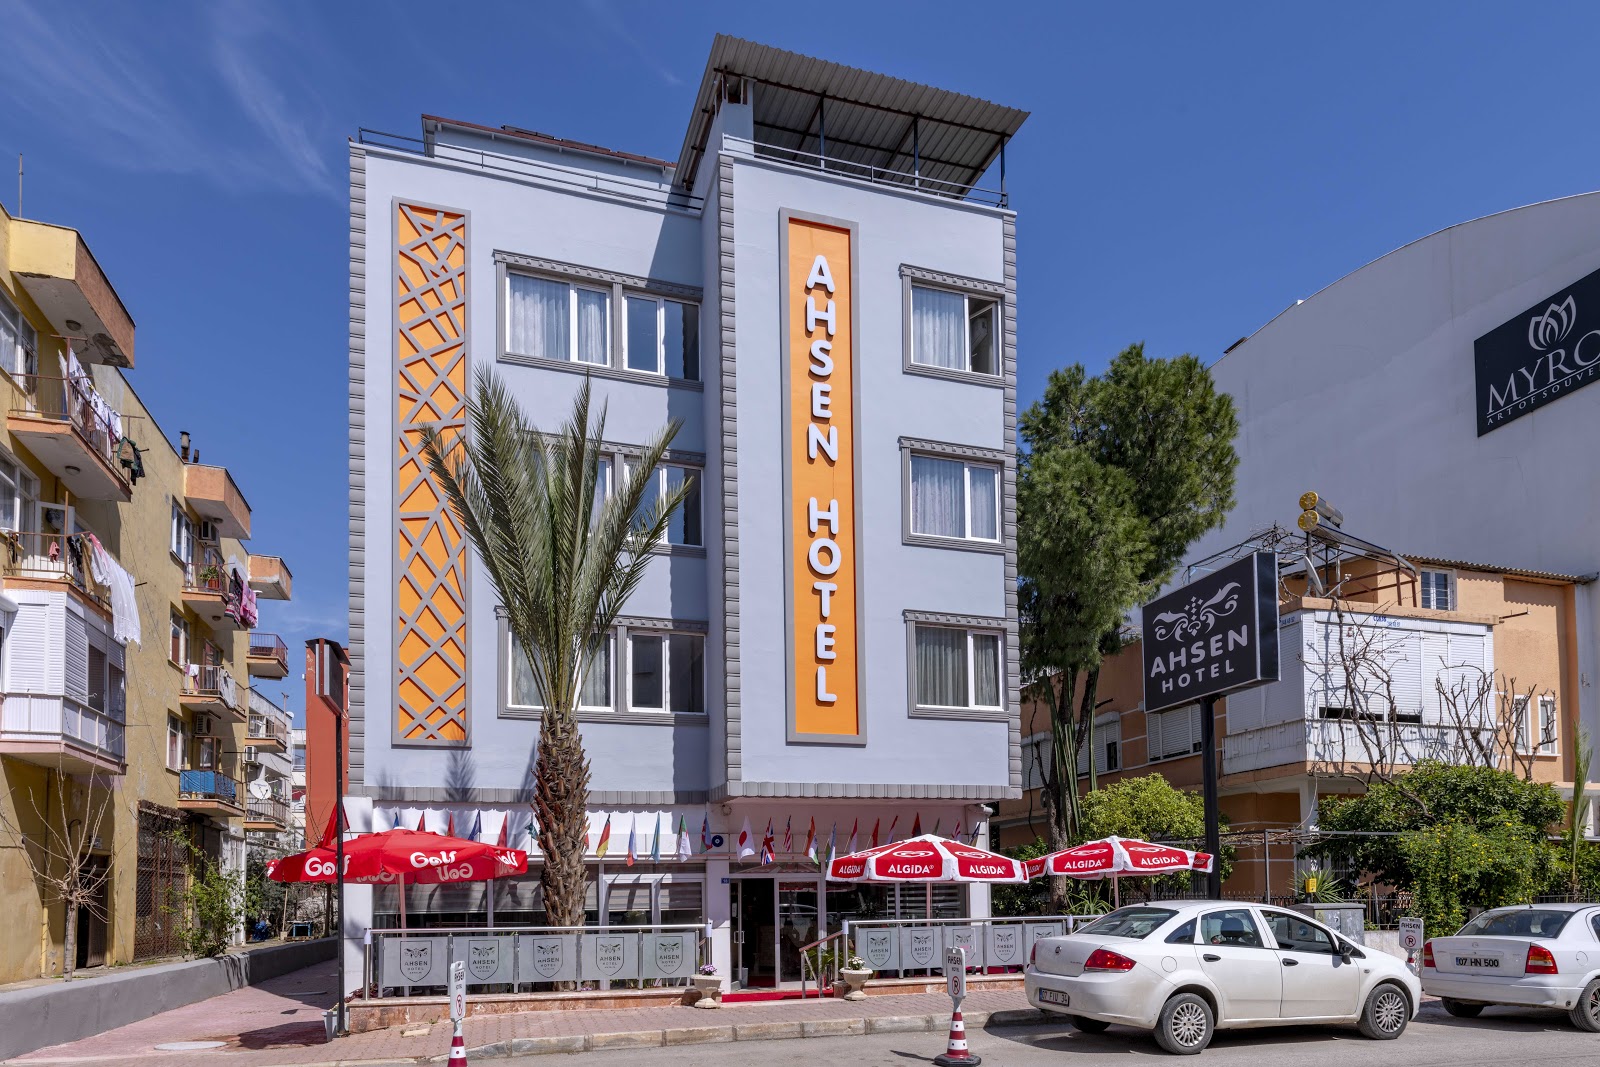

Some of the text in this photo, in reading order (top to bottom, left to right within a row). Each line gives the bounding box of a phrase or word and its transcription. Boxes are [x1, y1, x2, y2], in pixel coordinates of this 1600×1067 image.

[1487, 366, 1600, 426] ART OF SOUVE
[806, 254, 842, 702] AHSEN HOTEL
[1150, 624, 1248, 678] AHSEN
[1161, 659, 1235, 693] HOTEL
[304, 854, 352, 877] Gof
[409, 850, 457, 868] Golf
[495, 850, 519, 867] olf
[1458, 958, 1499, 967] 07 HN 500
